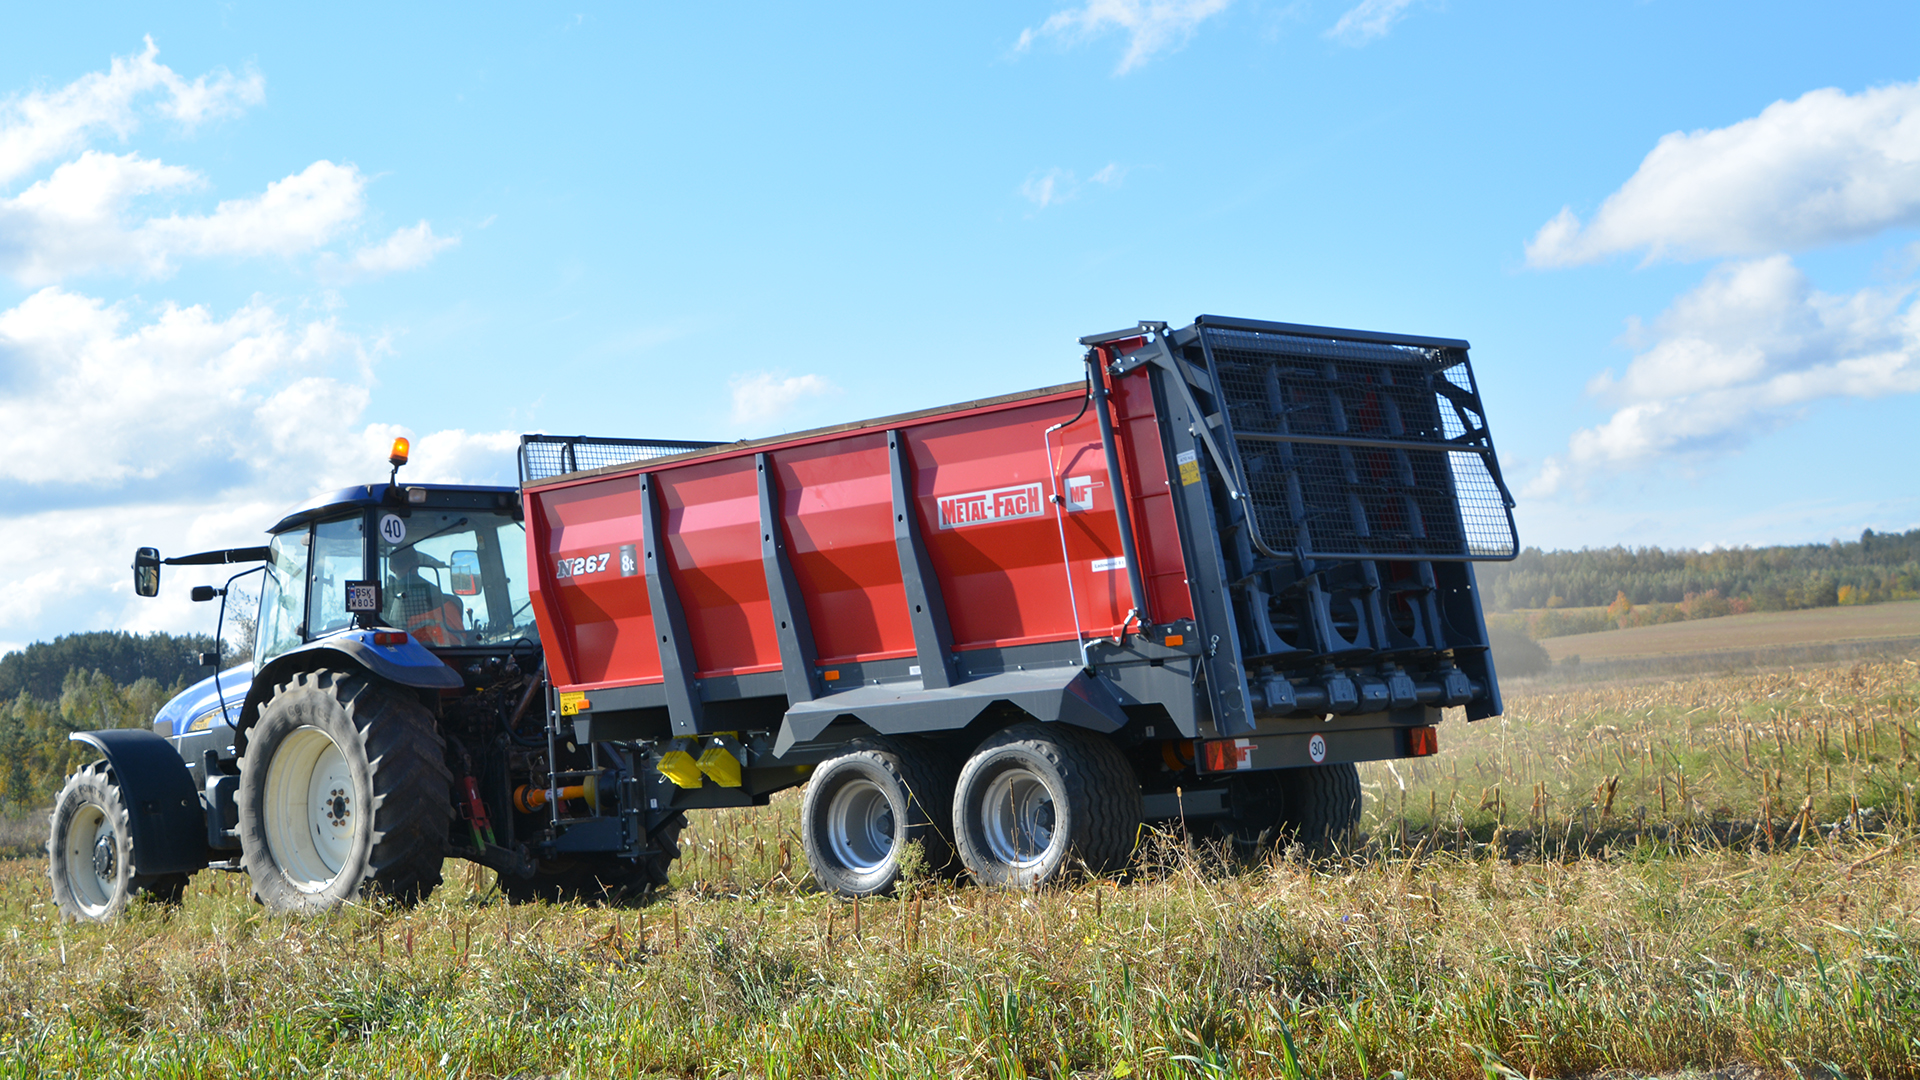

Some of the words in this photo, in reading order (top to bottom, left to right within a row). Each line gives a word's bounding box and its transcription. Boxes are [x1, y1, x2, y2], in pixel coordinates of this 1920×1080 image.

[1070, 482, 1103, 503] MF
[941, 487, 1040, 525] METAL-FACH
[384, 519, 401, 538] 40
[556, 552, 610, 579] N267
[621, 555, 635, 571] 8t
[356, 588, 372, 598] BSK
[352, 598, 374, 608] W805
[1311, 741, 1324, 756] 30
